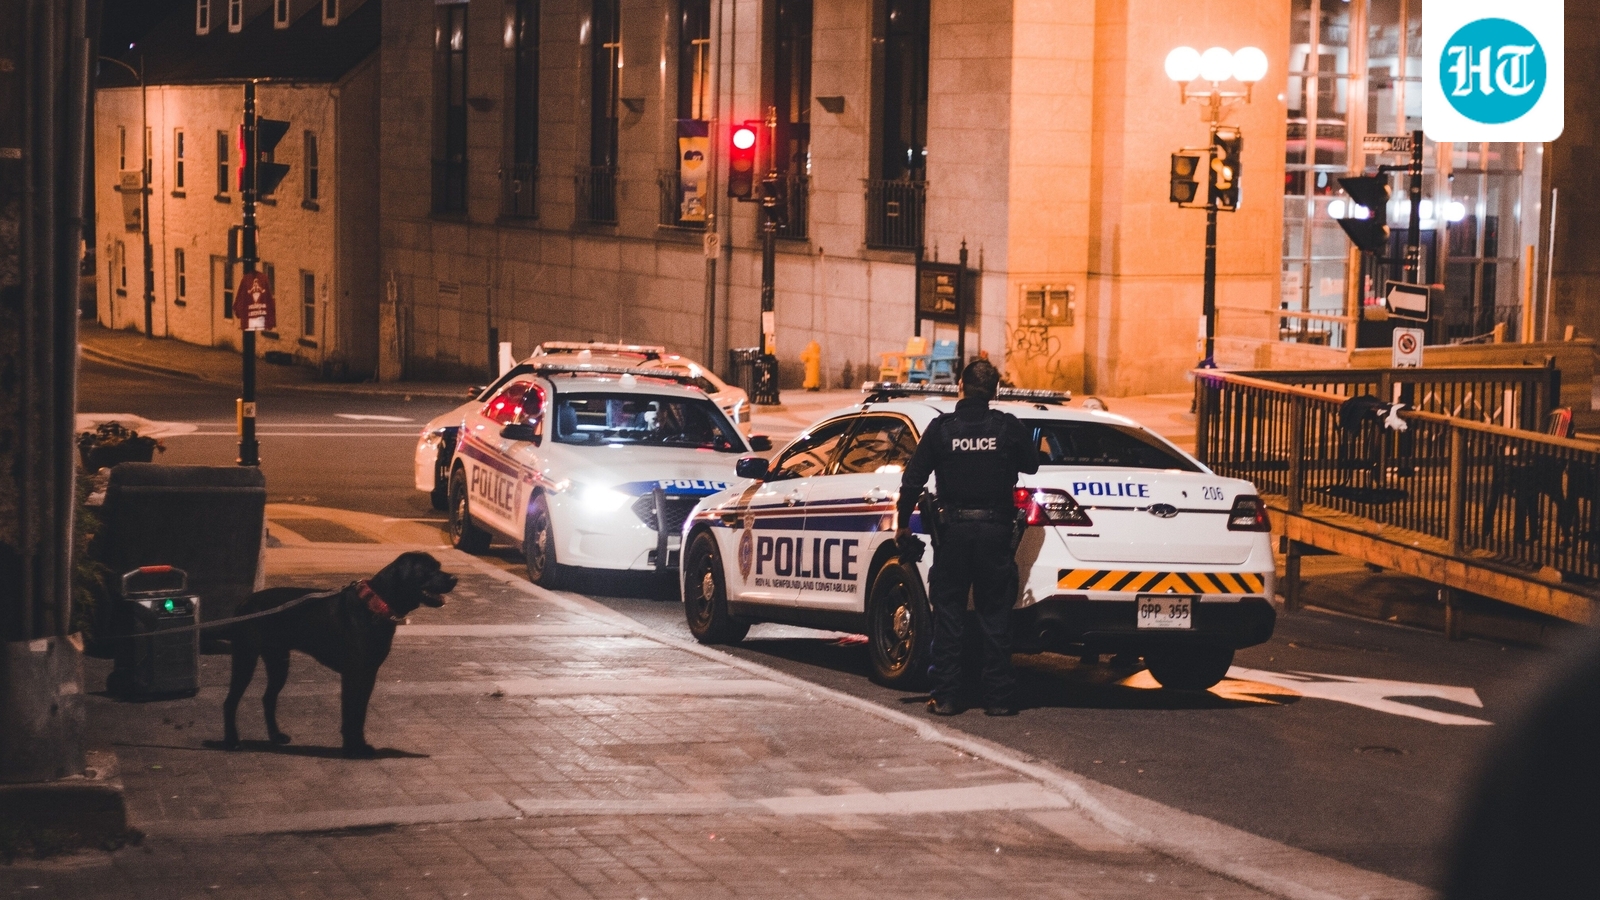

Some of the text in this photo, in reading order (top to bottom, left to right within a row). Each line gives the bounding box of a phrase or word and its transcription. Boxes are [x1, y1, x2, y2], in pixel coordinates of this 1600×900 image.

[1392, 137, 1410, 151] COVE
[952, 437, 997, 451] POLICE
[471, 464, 514, 512] POLICE
[1072, 481, 1150, 498] POLICE
[1202, 486, 1224, 501] 206
[755, 535, 859, 581] POLICE
[755, 577, 857, 594] ROYAL NEWFOUNDLAND CONSTABULARY
[1141, 604, 1189, 619] GPP 355
